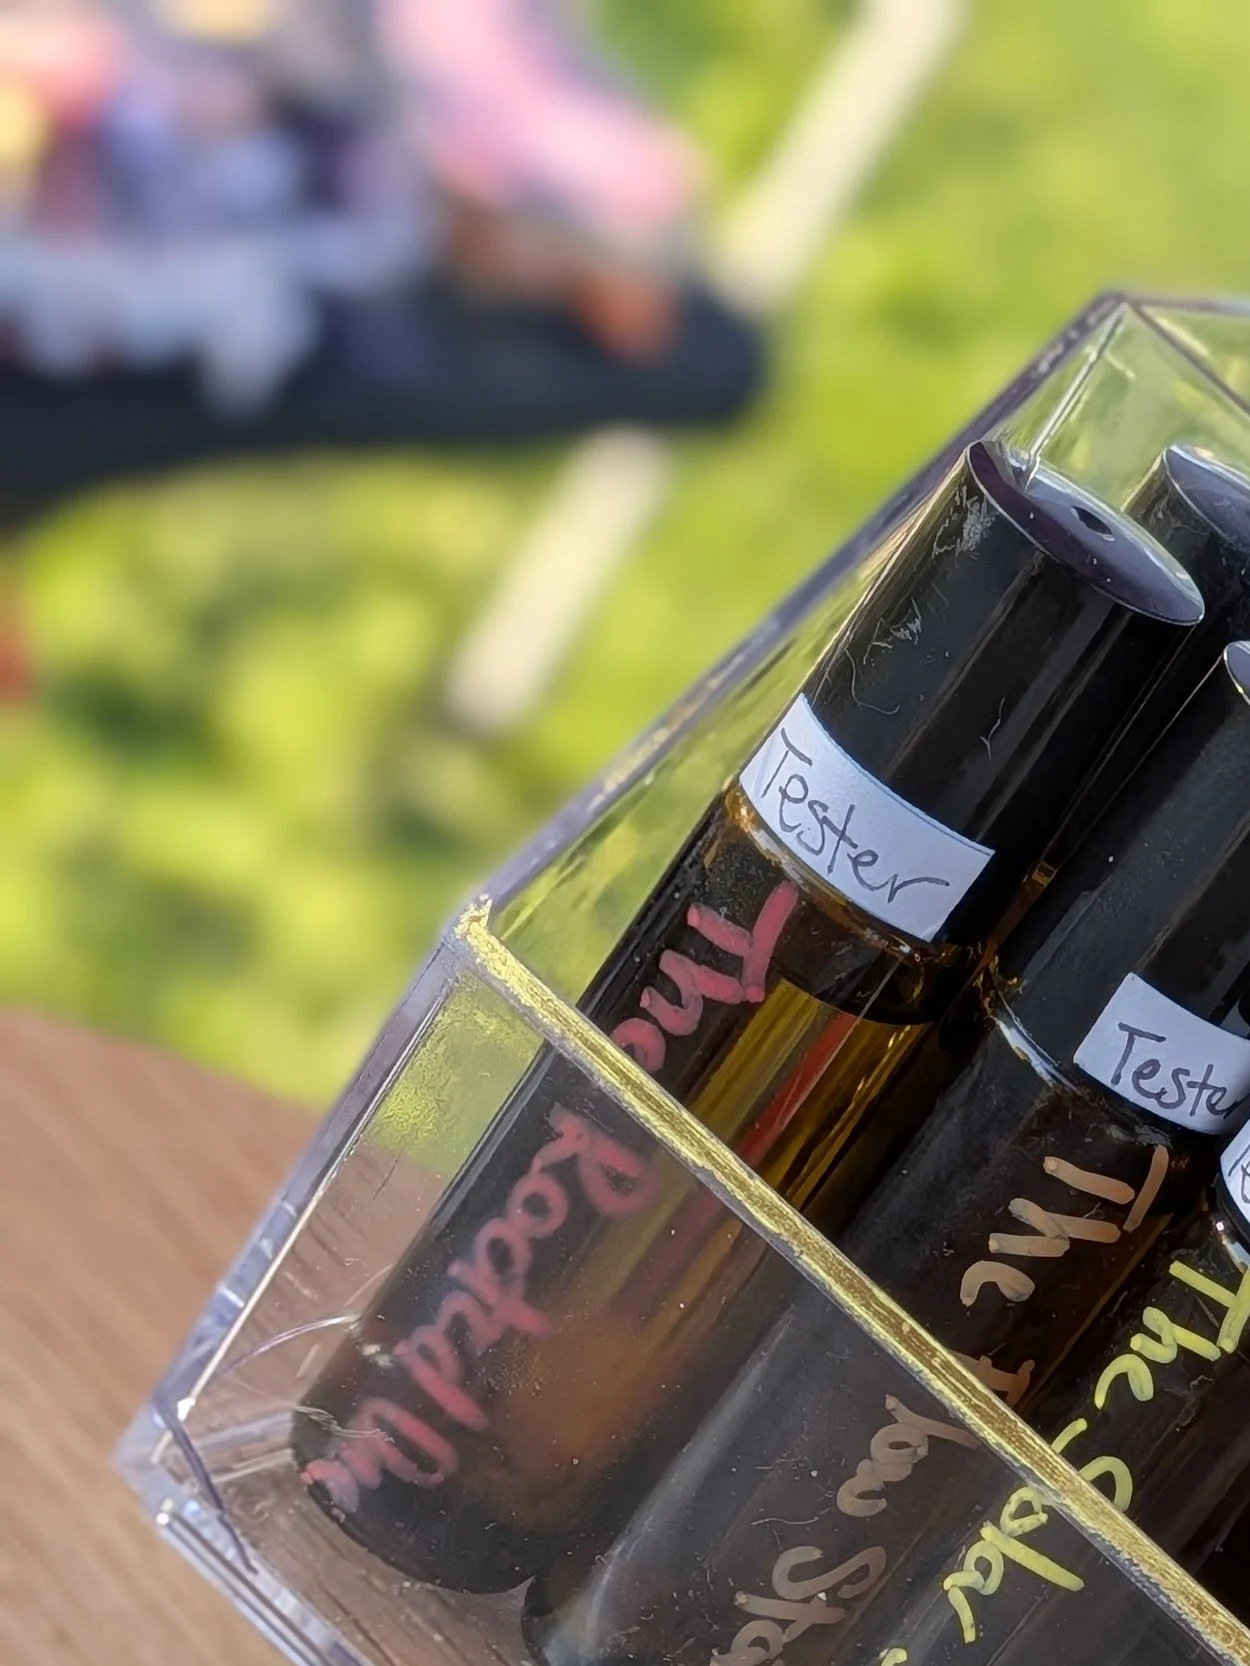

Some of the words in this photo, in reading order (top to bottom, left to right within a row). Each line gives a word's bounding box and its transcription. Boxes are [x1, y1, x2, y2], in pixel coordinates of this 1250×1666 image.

[760, 727, 950, 903] Tester
[610, 880, 799, 1071] The
[959, 1145, 1170, 1307] The
[943, 1418, 1133, 1643] Solar
